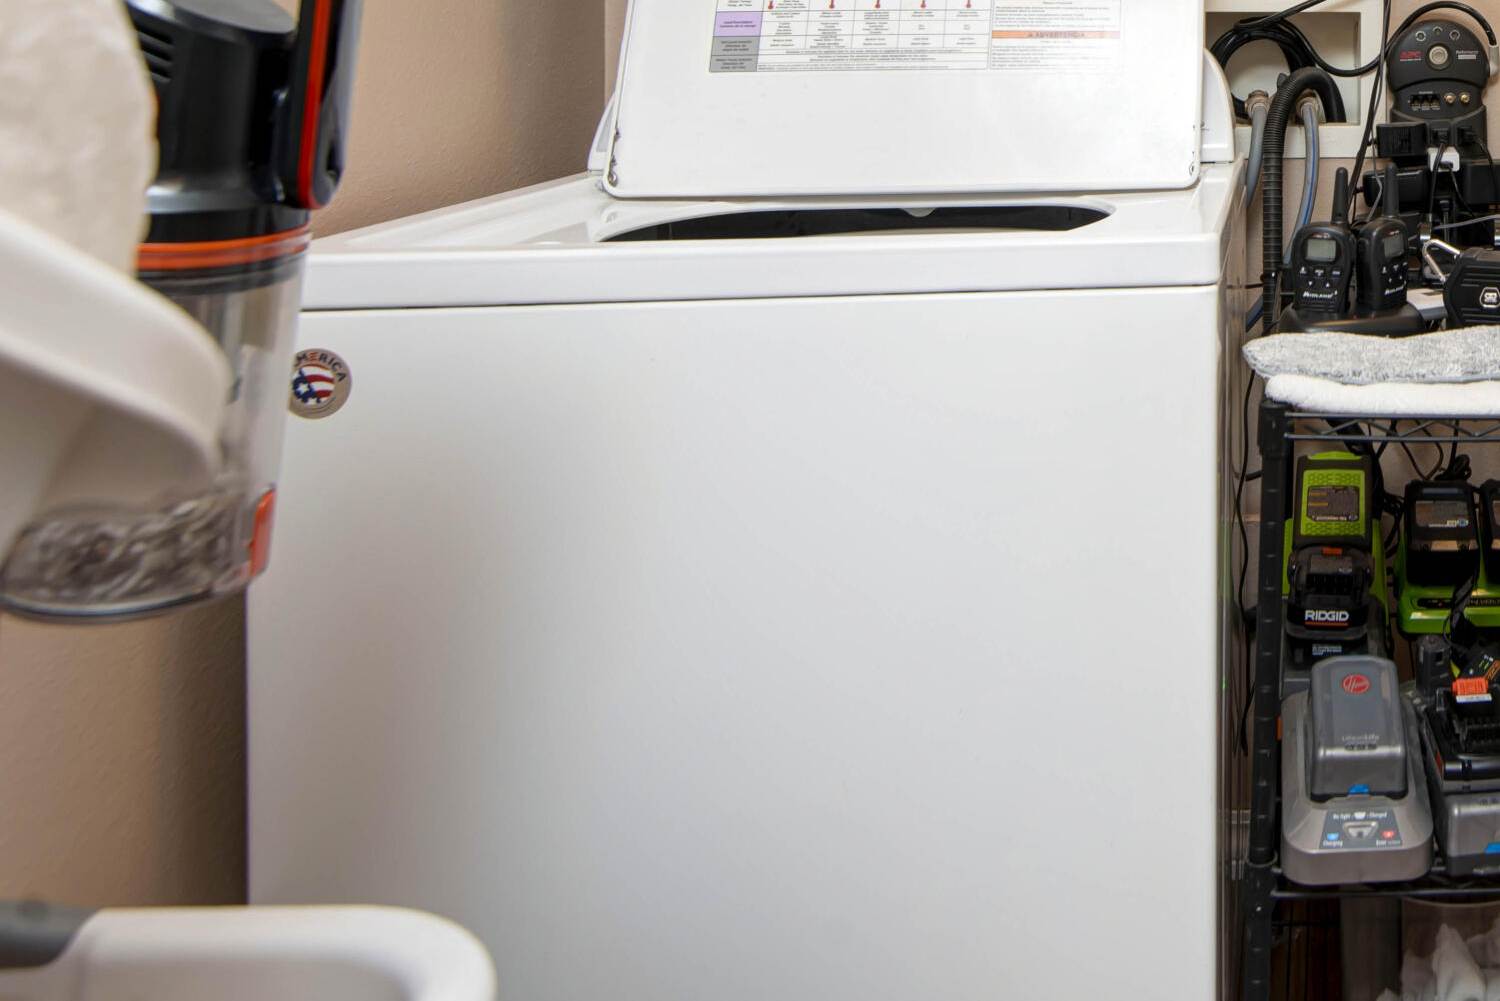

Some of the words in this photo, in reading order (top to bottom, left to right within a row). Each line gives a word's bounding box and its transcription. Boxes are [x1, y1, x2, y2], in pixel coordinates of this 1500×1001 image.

[1400, 50, 1421, 59] APC
[294, 352, 346, 382] MERICA
[1305, 610, 1349, 622] RIDGID
